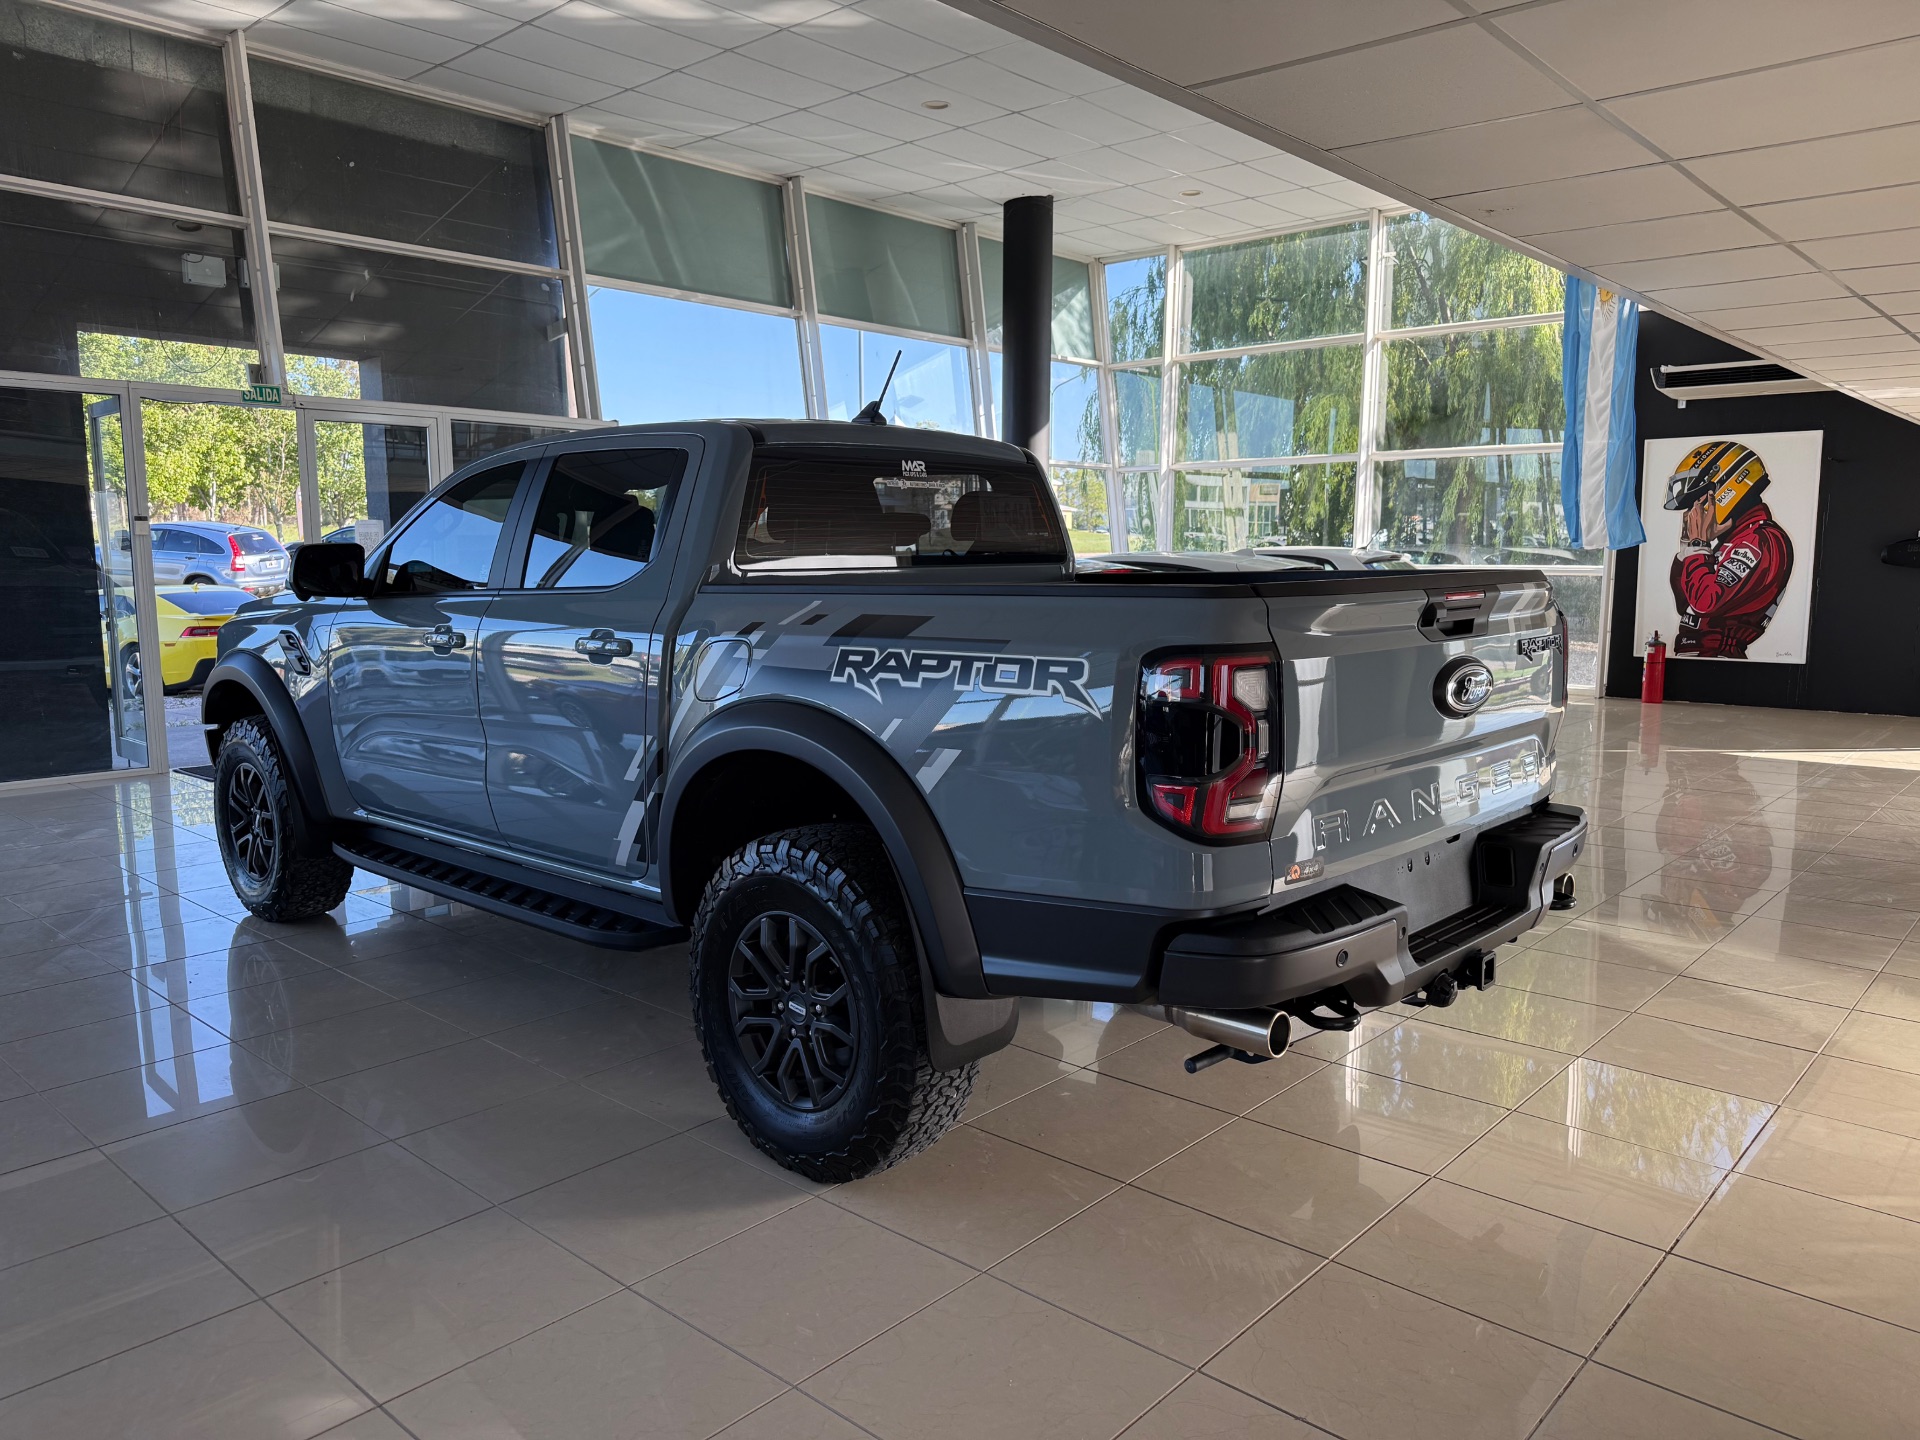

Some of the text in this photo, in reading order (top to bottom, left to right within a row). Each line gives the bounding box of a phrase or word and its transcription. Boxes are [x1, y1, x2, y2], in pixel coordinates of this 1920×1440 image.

[243, 387, 280, 402] SALIDA
[901, 460, 926, 472] MAR
[1716, 487, 1733, 504] BOSS
[1732, 549, 1755, 564] Marlboro
[1727, 559, 1748, 573] BOSS
[1517, 633, 1563, 662] RAPTOR
[830, 646, 1103, 722] RAPTOR
[1461, 675, 1488, 701] Ford
[1311, 750, 1541, 851] RANGER
